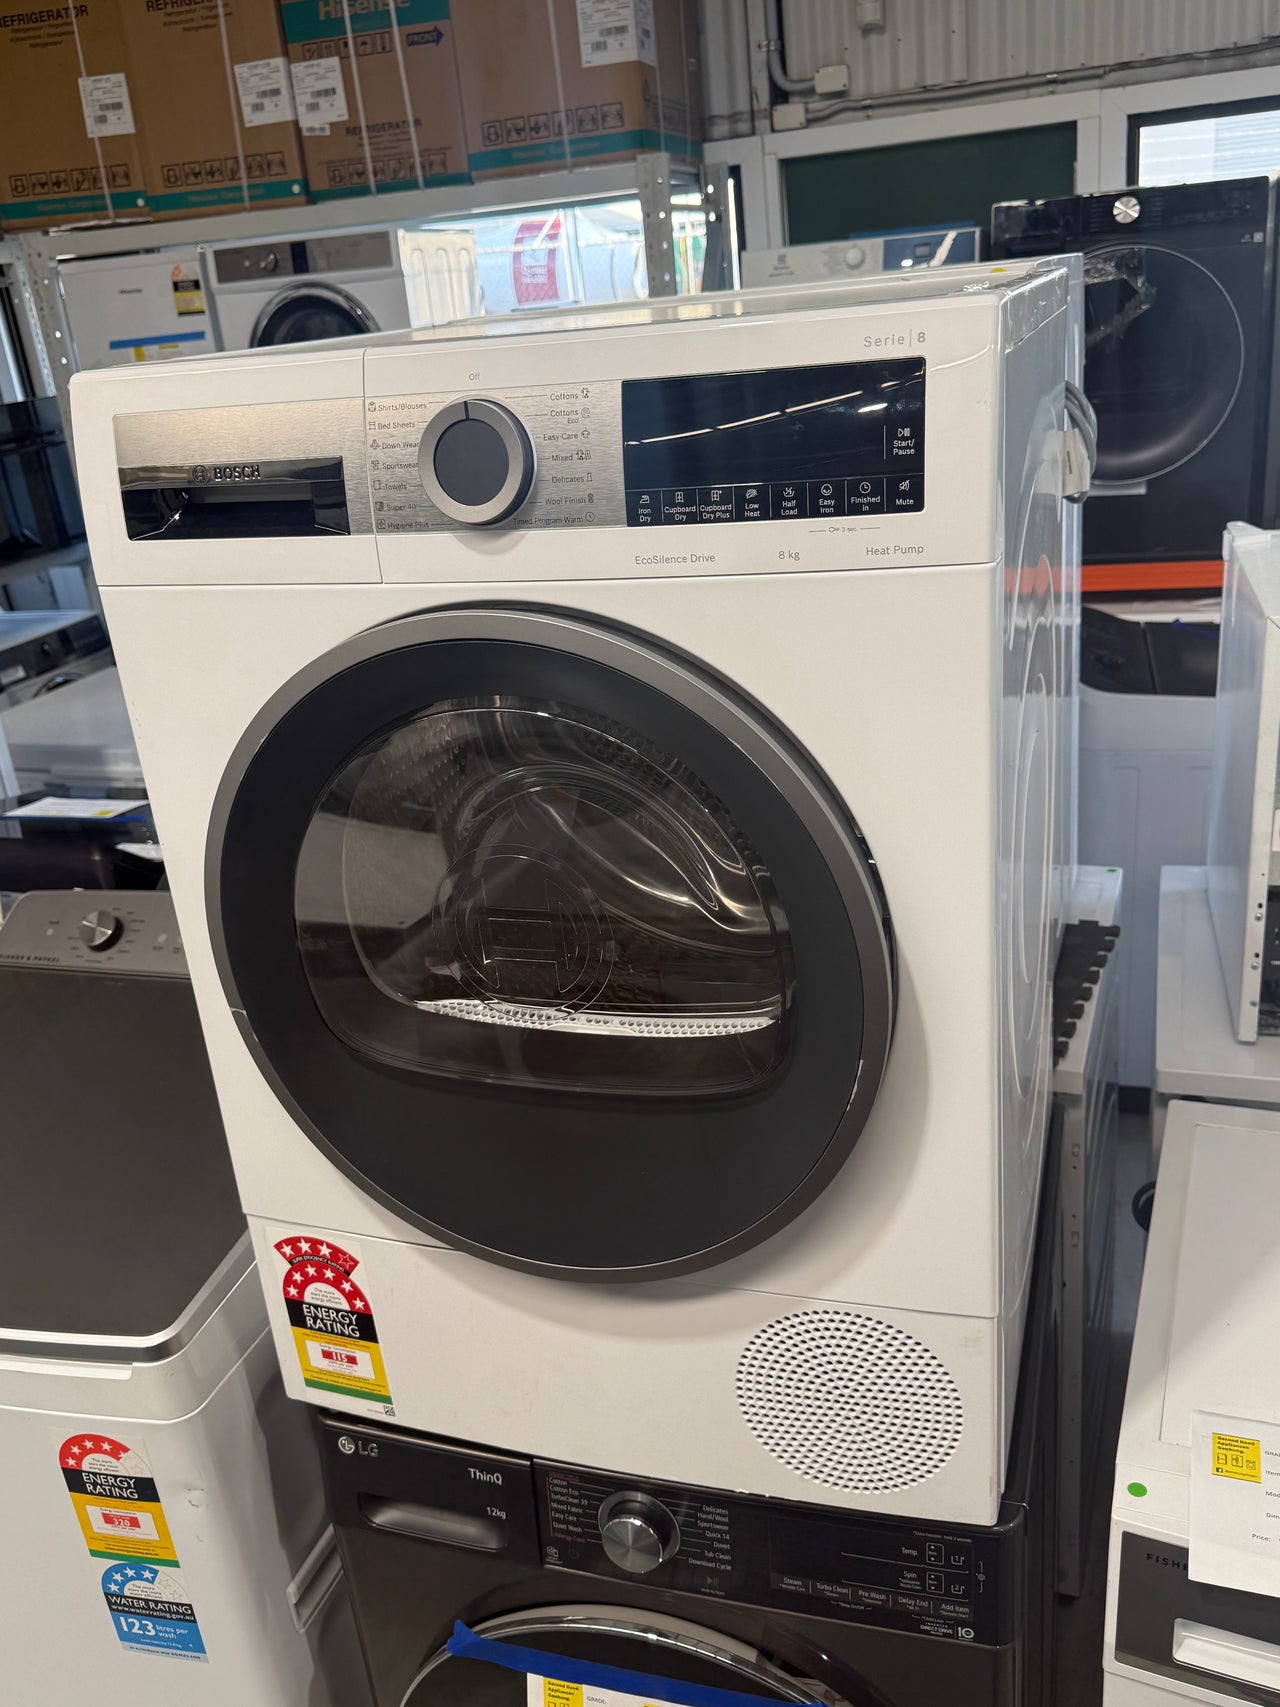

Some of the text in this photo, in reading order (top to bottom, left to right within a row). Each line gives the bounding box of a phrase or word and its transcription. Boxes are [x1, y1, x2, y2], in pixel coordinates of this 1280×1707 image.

[345, 118, 421, 136] RERIGERATR
[863, 332, 926, 348] Serie 8
[468, 372, 481, 382] Off
[549, 393, 579, 401] Cottons
[377, 402, 427, 412] Shirts/Blouses
[550, 409, 579, 417] Cottons
[377, 421, 416, 430] Bed Sheets
[381, 440, 420, 450] Down Wear
[893, 439, 915, 447] Start/
[551, 453, 573, 462] Mixed
[382, 462, 418, 471] Sportswear
[213, 464, 261, 482] BOSCH
[551, 476, 585, 484] Delicates
[384, 483, 407, 491] Towels
[564, 497, 586, 505] Finish
[819, 499, 835, 507] Easy
[850, 496, 881, 504] Finished
[664, 505, 696, 513] Cupboard
[700, 503, 732, 512] Cupboard
[781, 508, 798, 516] Load
[513, 516, 584, 525] Timed Program Warm
[639, 515, 651, 523] Dry
[702, 513, 714, 521] Dry
[387, 522, 413, 530] Hygiene
[778, 550, 800, 561] 8 kg
[866, 545, 924, 556] Heat Pump
[635, 553, 716, 565] EcoSilence Drive
[302, 1304, 358, 1325] ENERGY
[306, 1316, 360, 1338] RATING
[332, 1352, 349, 1363] 115
[1217, 1436, 1239, 1444] Second
[358, 1440, 379, 1458] LG
[1217, 1441, 1251, 1450] Appliances
[82, 1472, 136, 1489] ENERGY
[468, 1467, 503, 1486] ThinQ
[548, 1476, 568, 1487] Cotton
[86, 1483, 139, 1499] RATING
[549, 1484, 568, 1494] Cotton
[486, 1506, 506, 1520] 12kg
[702, 1504, 729, 1515] Delicates
[552, 1510, 578, 1522] Easy Care
[697, 1512, 729, 1523] Hand/Wool
[113, 1518, 131, 1527] 320
[697, 1520, 729, 1531] Sportswear
[567, 1524, 583, 1533] Wash
[705, 1530, 721, 1538] Quick
[1252, 1533, 1271, 1543] Price:
[713, 1541, 730, 1550] Duvet
[704, 1550, 732, 1560] Tub Clean
[688, 1557, 732, 1571] Download Cycle
[903, 1570, 918, 1579] Spin
[783, 1577, 802, 1586] Steam
[816, 1582, 832, 1592] Turbo
[832, 1584, 849, 1594] Clean
[858, 1589, 870, 1598] Pre
[870, 1592, 887, 1601] Wash
[108, 1595, 192, 1615] WATER RATING
[898, 1596, 929, 1607] Delay End
[941, 1603, 970, 1613] Add Item
[119, 1616, 156, 1636] 123
[155, 1624, 189, 1635] litres per
[157, 1631, 177, 1639] wash
[548, 1680, 566, 1689] Second
[548, 1687, 575, 1696] Appliances
